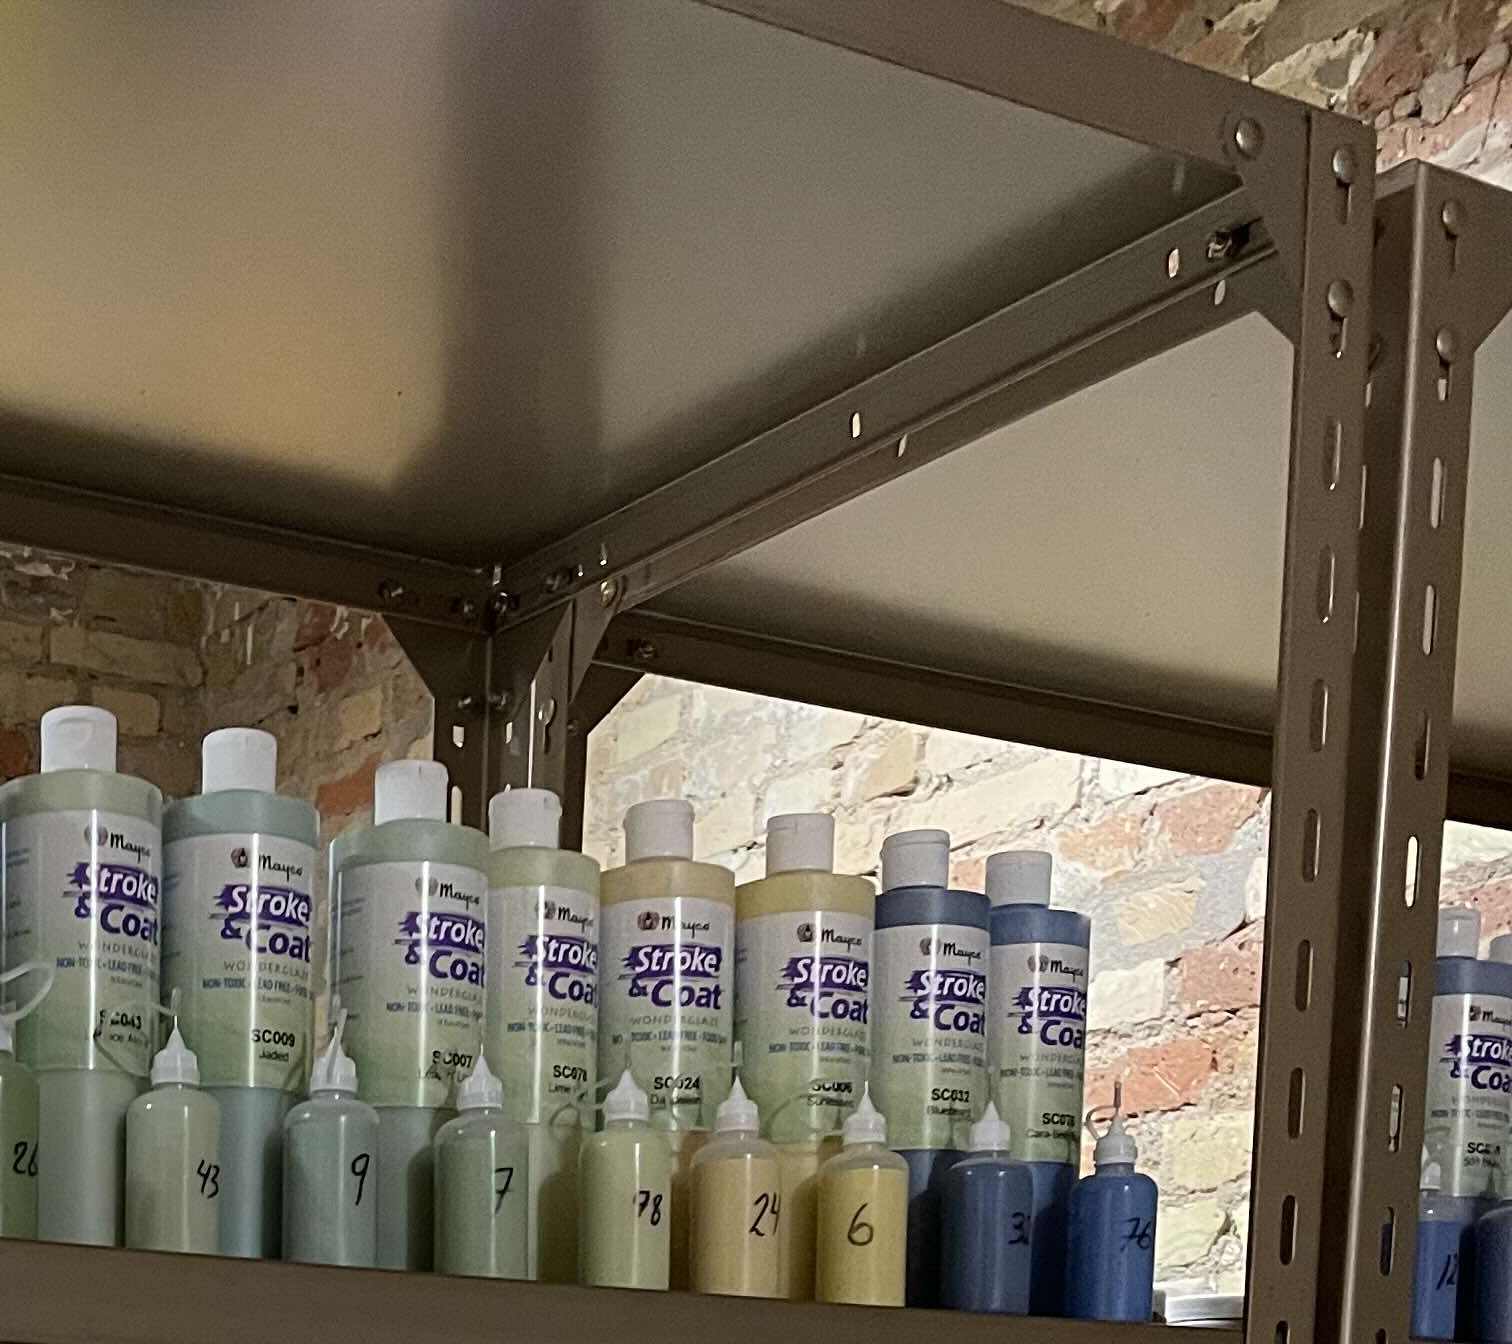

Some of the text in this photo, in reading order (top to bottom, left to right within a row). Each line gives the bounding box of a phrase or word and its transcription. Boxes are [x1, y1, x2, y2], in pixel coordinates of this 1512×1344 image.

[635, 947, 718, 974] Stroke
[628, 976, 722, 1010] & Coat
[918, 974, 985, 1001] Stroke
[909, 999, 986, 1037] & Coat
[252, 1028, 296, 1048] SC009
[11, 1140, 40, 1177] 26
[196, 1159, 220, 1199] 43
[351, 1153, 371, 1205] 9
[494, 1167, 513, 1214] 7
[634, 1190, 662, 1227] 78
[748, 1193, 780, 1237] 24
[847, 1203, 874, 1246] 6
